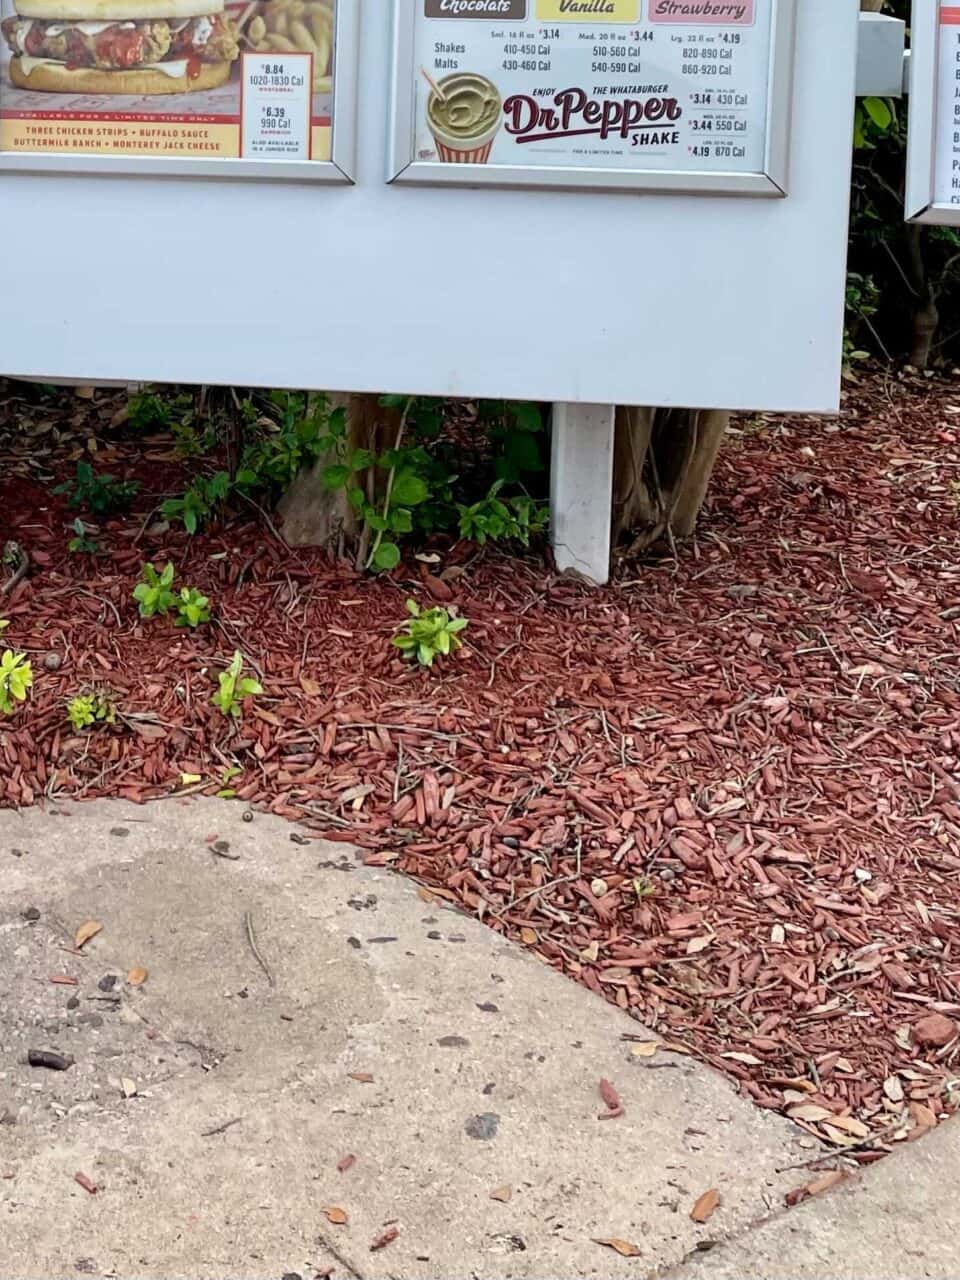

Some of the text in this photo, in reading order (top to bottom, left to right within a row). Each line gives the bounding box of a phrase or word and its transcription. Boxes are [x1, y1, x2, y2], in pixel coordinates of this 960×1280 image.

[559, 0, 615, 13] Vanilla
[656, 0, 746, 19] Strawberry
[434, 43, 465, 53] Shakes
[434, 59, 458, 69] Malts
[291, 75, 304, 85] Cal
[533, 88, 557, 96] ENJOY
[592, 85, 668, 95] THE WHATABURGER
[504, 88, 682, 139] Dr Pepper
[14, 139, 160, 149] BUTTERMILK MONTEREY
[632, 132, 680, 146] SHAKE
